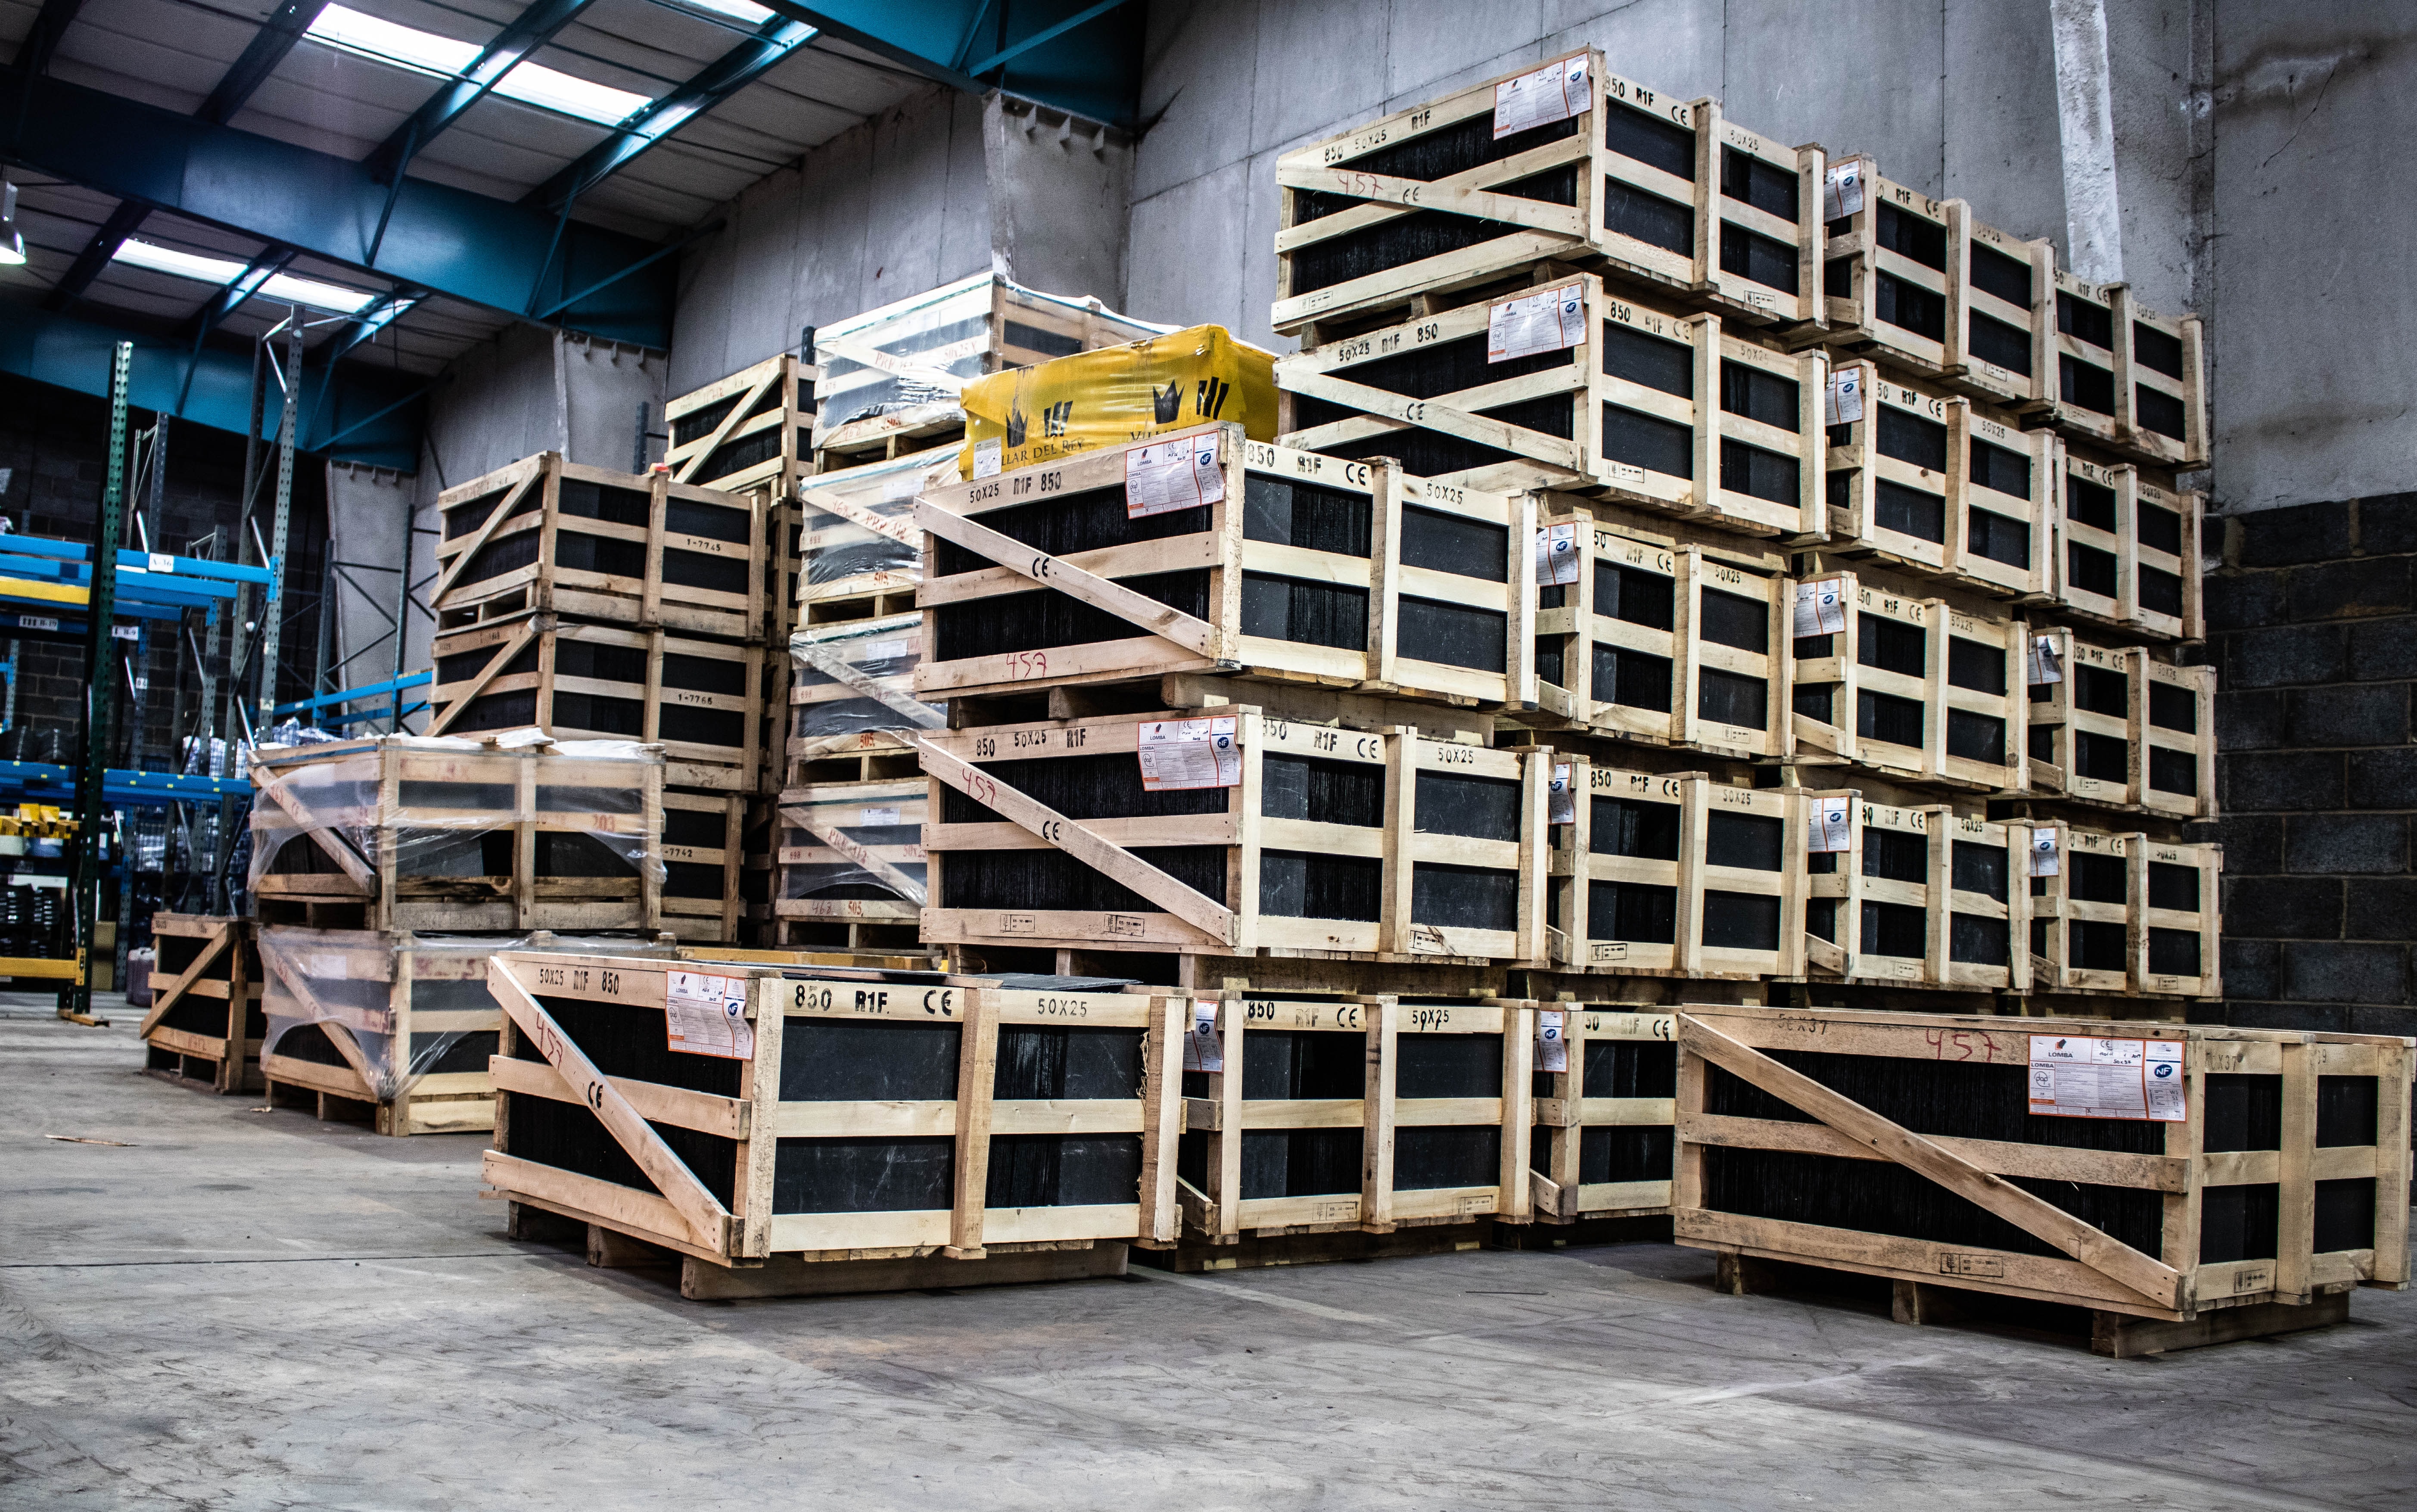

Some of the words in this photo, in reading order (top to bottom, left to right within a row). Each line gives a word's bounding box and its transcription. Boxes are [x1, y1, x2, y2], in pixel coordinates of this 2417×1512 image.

[1636, 87, 1654, 106] R1F
[1671, 106, 1687, 126] CE
[1325, 146, 1343, 162] 850
[1355, 132, 1387, 150] 50X25
[1412, 110, 1431, 131] R1F
[1730, 129, 1759, 151] 50X25
[1338, 172, 1384, 198] 457
[1403, 186, 1420, 205] CE
[1896, 188, 1911, 205] R1F
[1926, 200, 1939, 218] CE
[2053, 270, 2064, 285] 50
[1611, 302, 1630, 323] 850
[1674, 320, 1689, 340] CE
[1339, 342, 1370, 362] 50X25
[1381, 333, 1400, 353] R1F
[1418, 323, 1438, 342] 850
[1407, 403, 1425, 421] CE
[1878, 382, 1888, 399] 50
[1902, 389, 1917, 406] R1F
[1929, 398, 1942, 417] CE
[1982, 421, 2005, 439] 50X25
[1001, 451, 1027, 466] LLAR
[1033, 446, 1057, 458] DEL
[1201, 454, 1210, 464] NF
[1247, 443, 1275, 468] 850
[1297, 456, 1322, 475] R1F
[1346, 464, 1366, 486] CE
[970, 485, 999, 504] 50X25
[1013, 477, 1031, 495] R1F
[1041, 471, 1061, 492] 850
[1427, 483, 1463, 505] 50X25
[1557, 542, 1567, 550] NF
[1594, 533, 1606, 549] 50
[1658, 553, 1672, 573] CE
[1032, 557, 1050, 578] CE
[1716, 566, 1741, 584] 50X25
[1857, 588, 1871, 606] 50
[1884, 599, 1898, 615] R1F
[1910, 605, 1922, 622] CE
[1007, 652, 1047, 680] 457
[976, 738, 995, 757] 850
[1014, 730, 1046, 748] 50X25
[1066, 728, 1086, 748] R1F
[1218, 738, 1228, 747] NF
[1314, 730, 1338, 752] R1F
[1357, 738, 1378, 759] CE
[1438, 747, 1474, 764] 50X25
[962, 768, 995, 808] 457
[1591, 770, 1611, 788] 850
[1663, 779, 1679, 797] CE
[1723, 789, 1751, 805] 50X25
[1863, 805, 1873, 826] 50
[1911, 812, 1923, 829] CE
[1960, 818, 1983, 833] 50X25
[1042, 820, 1060, 841] CE
[665, 848, 693, 858] -7742
[2110, 838, 2122, 853] CE
[540, 969, 564, 986] 50X25
[573, 971, 588, 991] R1F
[602, 970, 619, 995] 850
[729, 1005, 737, 1014] NF
[796, 984, 831, 1012] 850
[923, 989, 952, 1017] CE
[1038, 998, 1087, 1017] 50X25
[1248, 1000, 1274, 1020] 850
[1295, 1008, 1319, 1027] R1F
[1337, 1007, 1358, 1028] CE
[1200, 1025, 1209, 1033] NF
[1585, 1014, 1599, 1031] 50
[1653, 1019, 1670, 1041] CE
[536, 1012, 564, 1071] 457
[1926, 1028, 2002, 1062] 457
[2156, 1067, 2172, 1076] NF
[587, 1081, 603, 1110] CE
